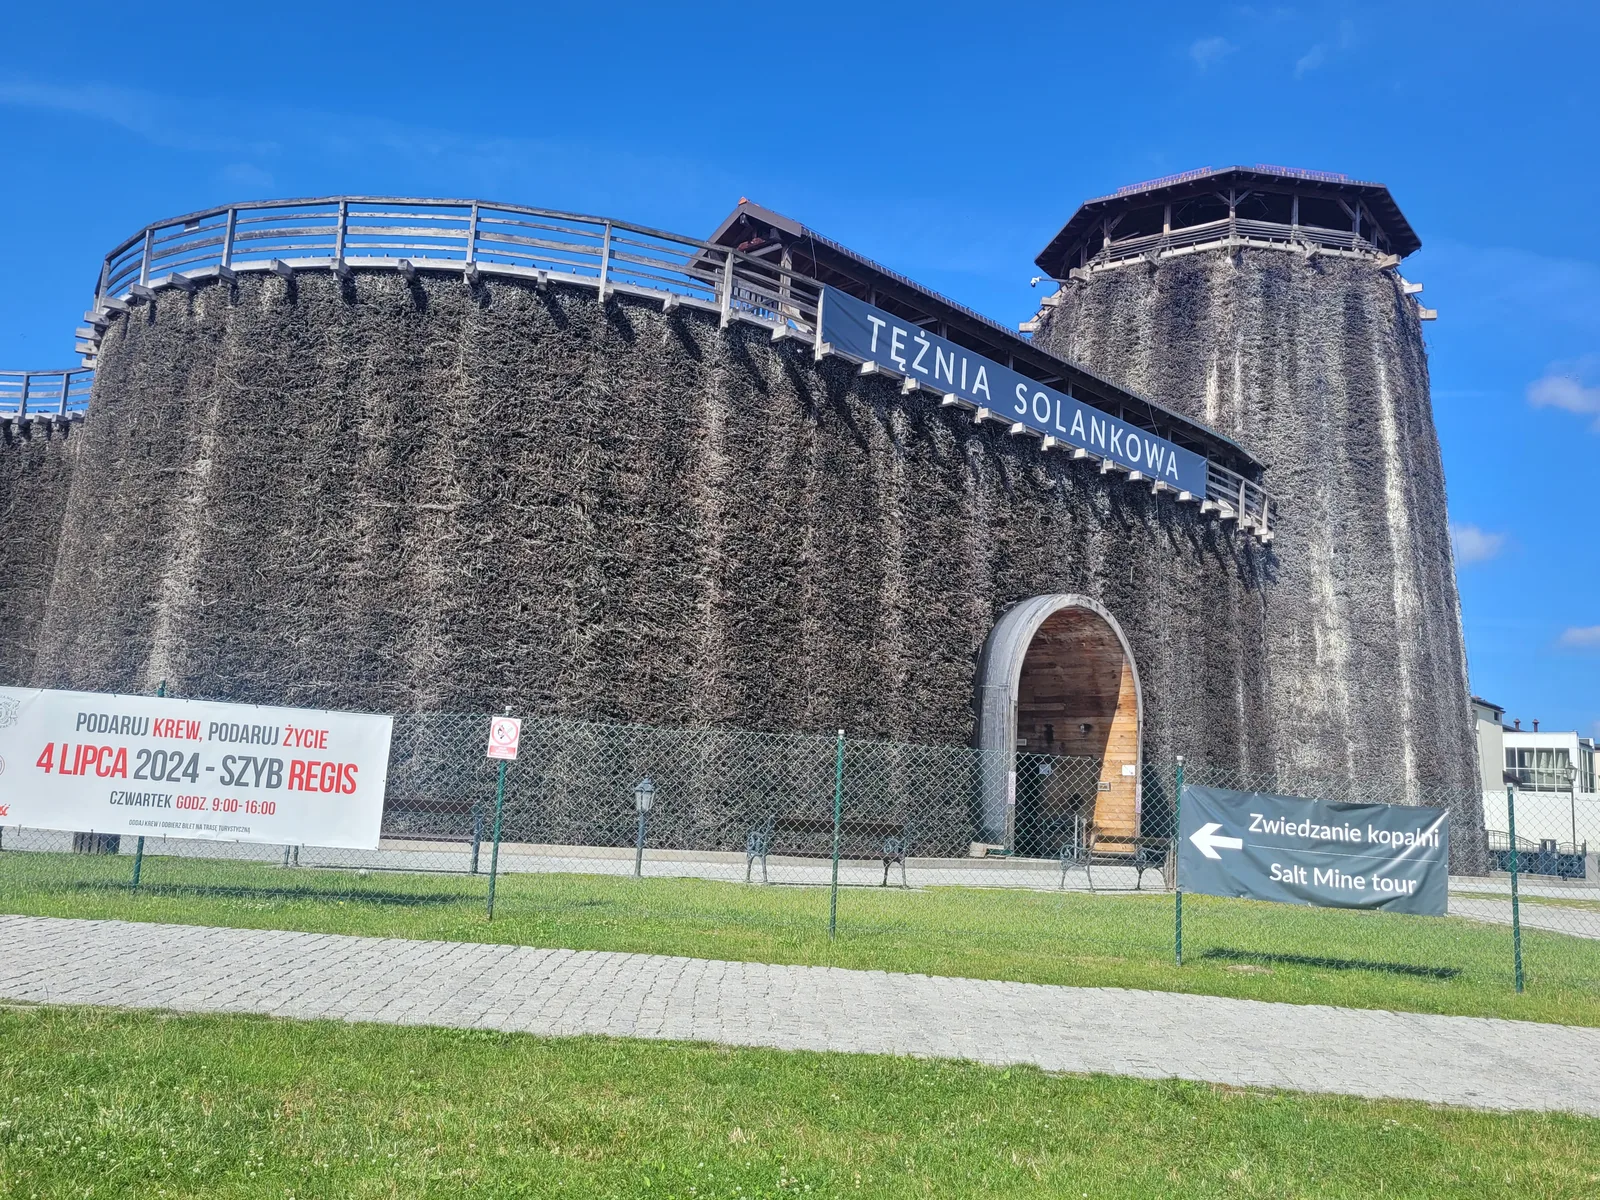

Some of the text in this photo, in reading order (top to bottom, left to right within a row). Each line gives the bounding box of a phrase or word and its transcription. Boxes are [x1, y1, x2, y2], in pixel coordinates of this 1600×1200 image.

[867, 314, 1178, 480] TĘŻNIA SOLANKOWA
[76, 712, 329, 749] PODARUJ KREW, PODARUJ ŻYCIE
[36, 742, 54, 773] 4
[59, 743, 127, 778] LIPCA
[133, 748, 200, 783] 2024
[220, 755, 284, 789] SZYB
[288, 760, 358, 794] REGIS
[109, 791, 172, 808] CZWARTEK
[176, 795, 208, 811] GODZ.
[218, 826, 250, 834] TURYSTYCZNĄ
[1248, 813, 1439, 849] Zwiedzanie kopalni
[1269, 863, 1417, 894] Salt Mine tour
